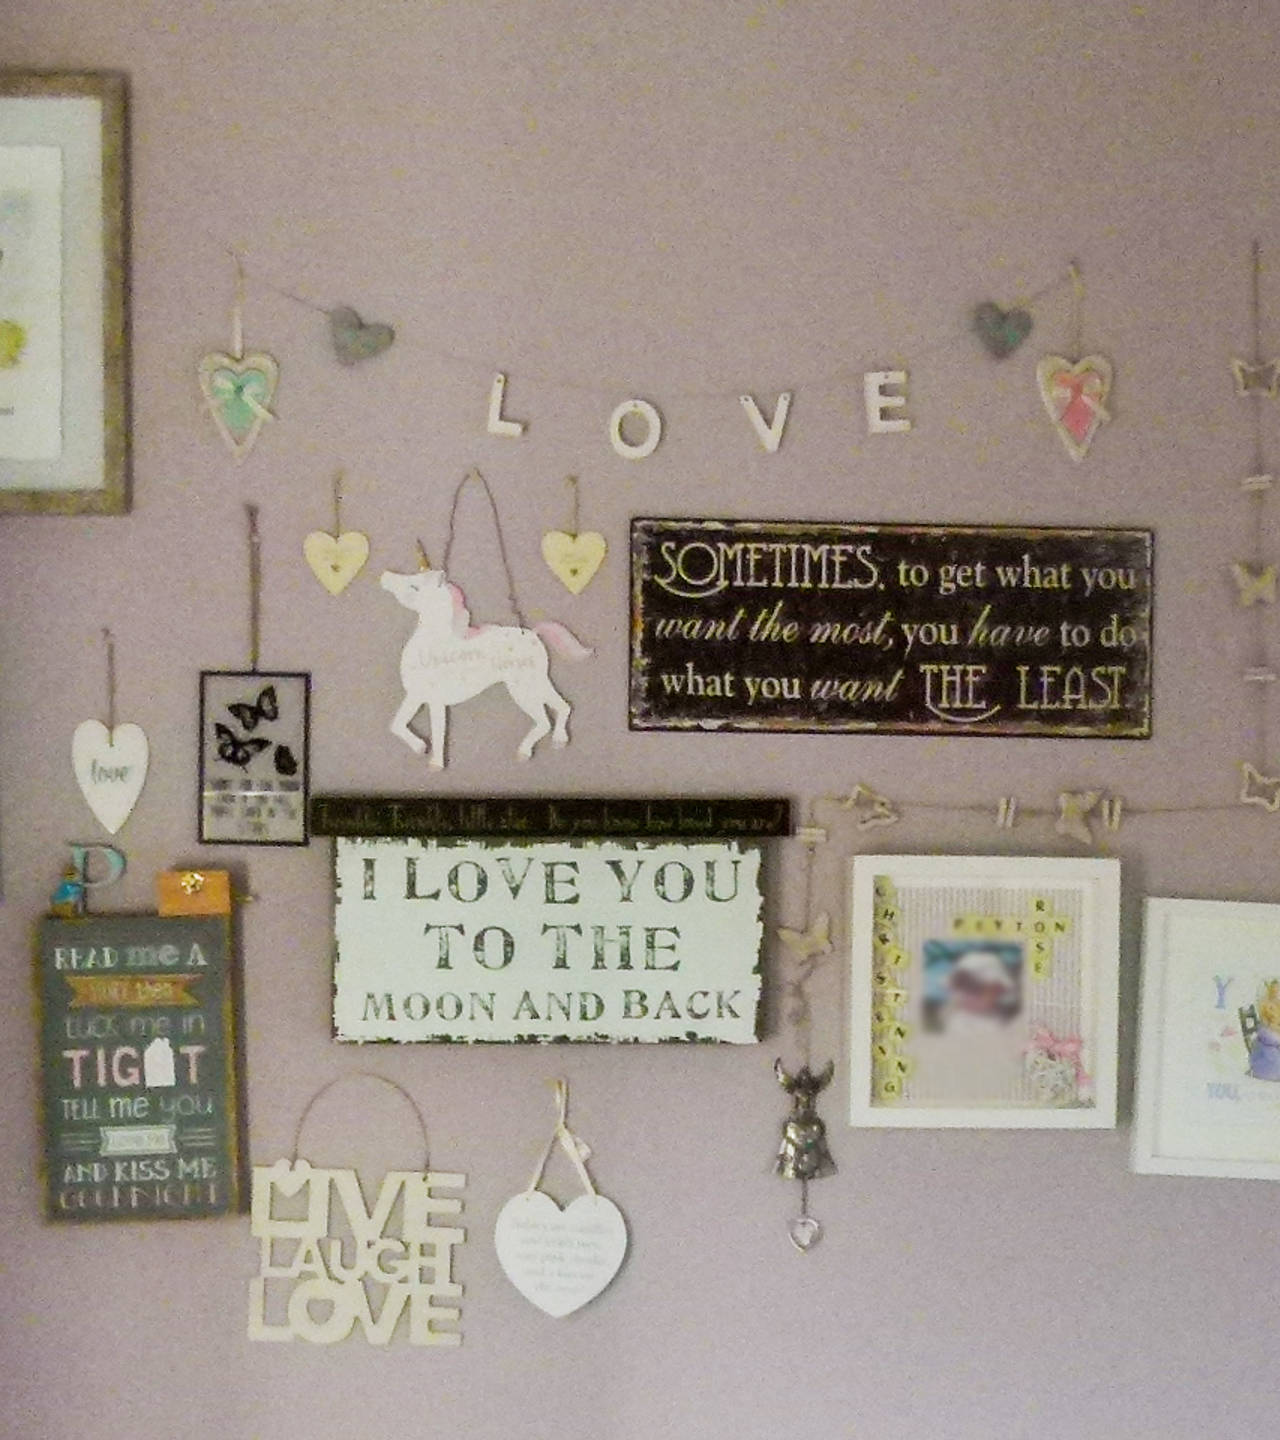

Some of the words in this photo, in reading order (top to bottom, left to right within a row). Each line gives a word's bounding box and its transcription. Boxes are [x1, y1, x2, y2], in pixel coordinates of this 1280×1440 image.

[897, 558, 929, 587] to
[939, 561, 987, 595] get
[996, 553, 1071, 590] what
[1083, 565, 1137, 601] you
[655, 608, 745, 641] want
[747, 599, 800, 643] the
[902, 621, 961, 661] you
[966, 602, 1050, 647] have
[1060, 618, 1091, 647] to
[1100, 615, 1137, 648] do
[661, 662, 735, 698] what
[744, 673, 801, 706] you
[810, 667, 904, 704] want
[919, 664, 1001, 724] THE
[361, 857, 378, 901] I
[404, 857, 582, 904] LOVE
[605, 858, 741, 903] YOU
[54, 946, 119, 970] READ
[186, 943, 209, 966] A
[424, 923, 515, 971] TO
[541, 923, 682, 972] THE
[361, 990, 497, 1022] MOON
[513, 990, 606, 1022] AND
[622, 988, 742, 1021] BACK
[62, 1045, 207, 1088] TIGT
[62, 1098, 100, 1120] TELL
[110, 1096, 150, 1119] me
[64, 1162, 108, 1184] AND
[114, 1159, 170, 1182] KISS
[177, 1156, 217, 1181] ME
[251, 1160, 466, 1244] LIVE
[261, 1235, 456, 1284] LAUGH
[248, 1277, 464, 1346] LOVE
